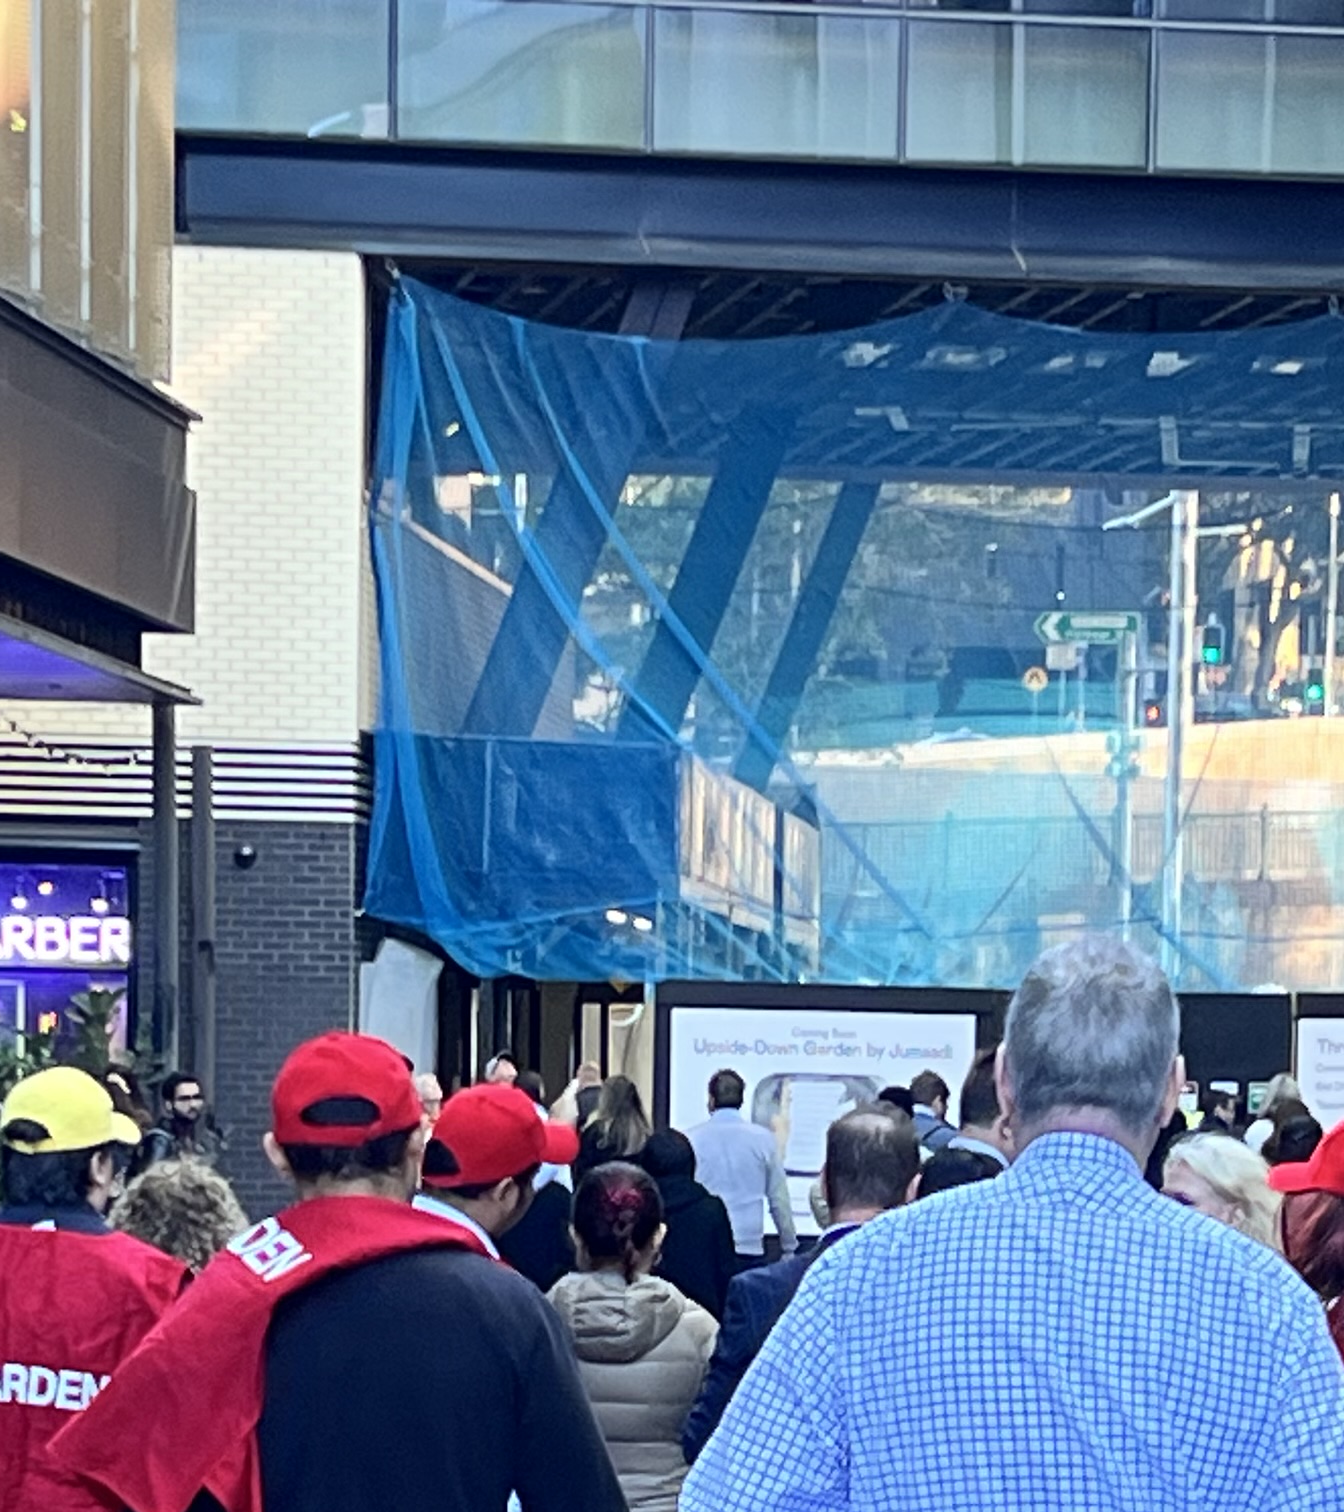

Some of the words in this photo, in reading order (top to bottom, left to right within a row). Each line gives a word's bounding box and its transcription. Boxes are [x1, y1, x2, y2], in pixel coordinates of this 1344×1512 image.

[693, 1038, 799, 1057] Upside-Down
[803, 1039, 862, 1057] Garden
[866, 1042, 886, 1061] by
